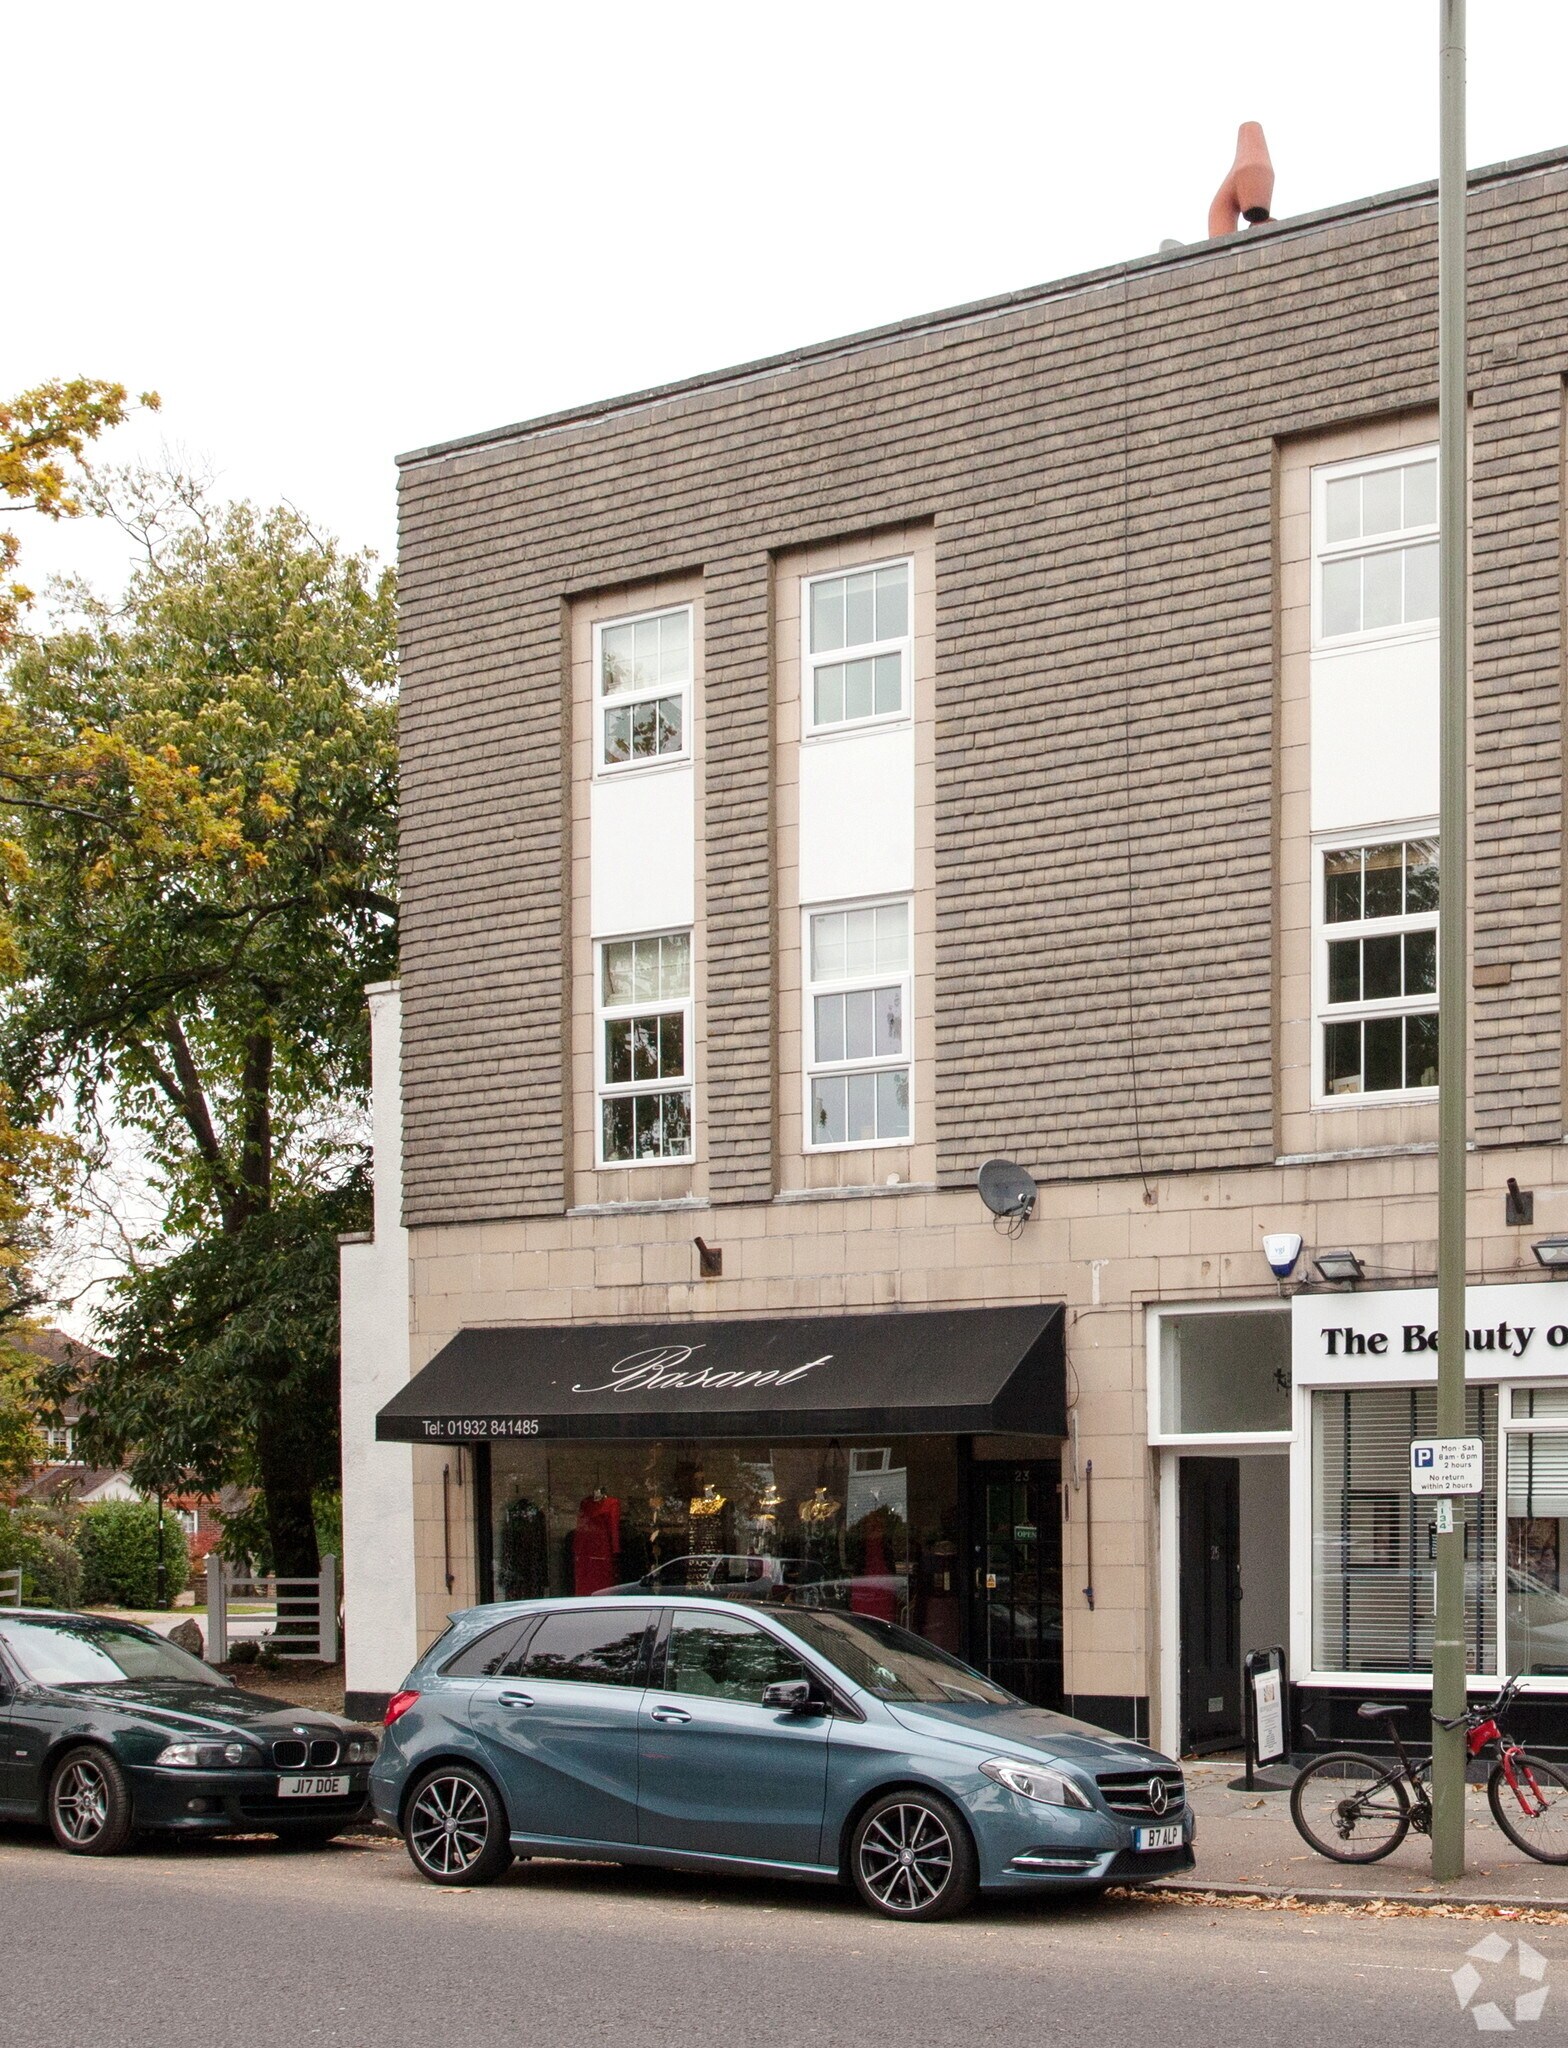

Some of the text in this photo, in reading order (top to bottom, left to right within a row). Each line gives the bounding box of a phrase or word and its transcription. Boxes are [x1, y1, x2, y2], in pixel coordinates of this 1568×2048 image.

[1321, 1326, 1388, 1355] The
[1401, 1321, 1536, 1357] Beuty
[572, 1343, 834, 1392] Basant
[422, 1419, 539, 1435] Tel: 01932 841485
[1418, 1449, 1431, 1467] P
[1015, 1470, 1030, 1482] 23
[1017, 1530, 1038, 1539] OPEN
[292, 1778, 340, 1794] J17 DOE
[1148, 1827, 1178, 1847] B7 ALP
